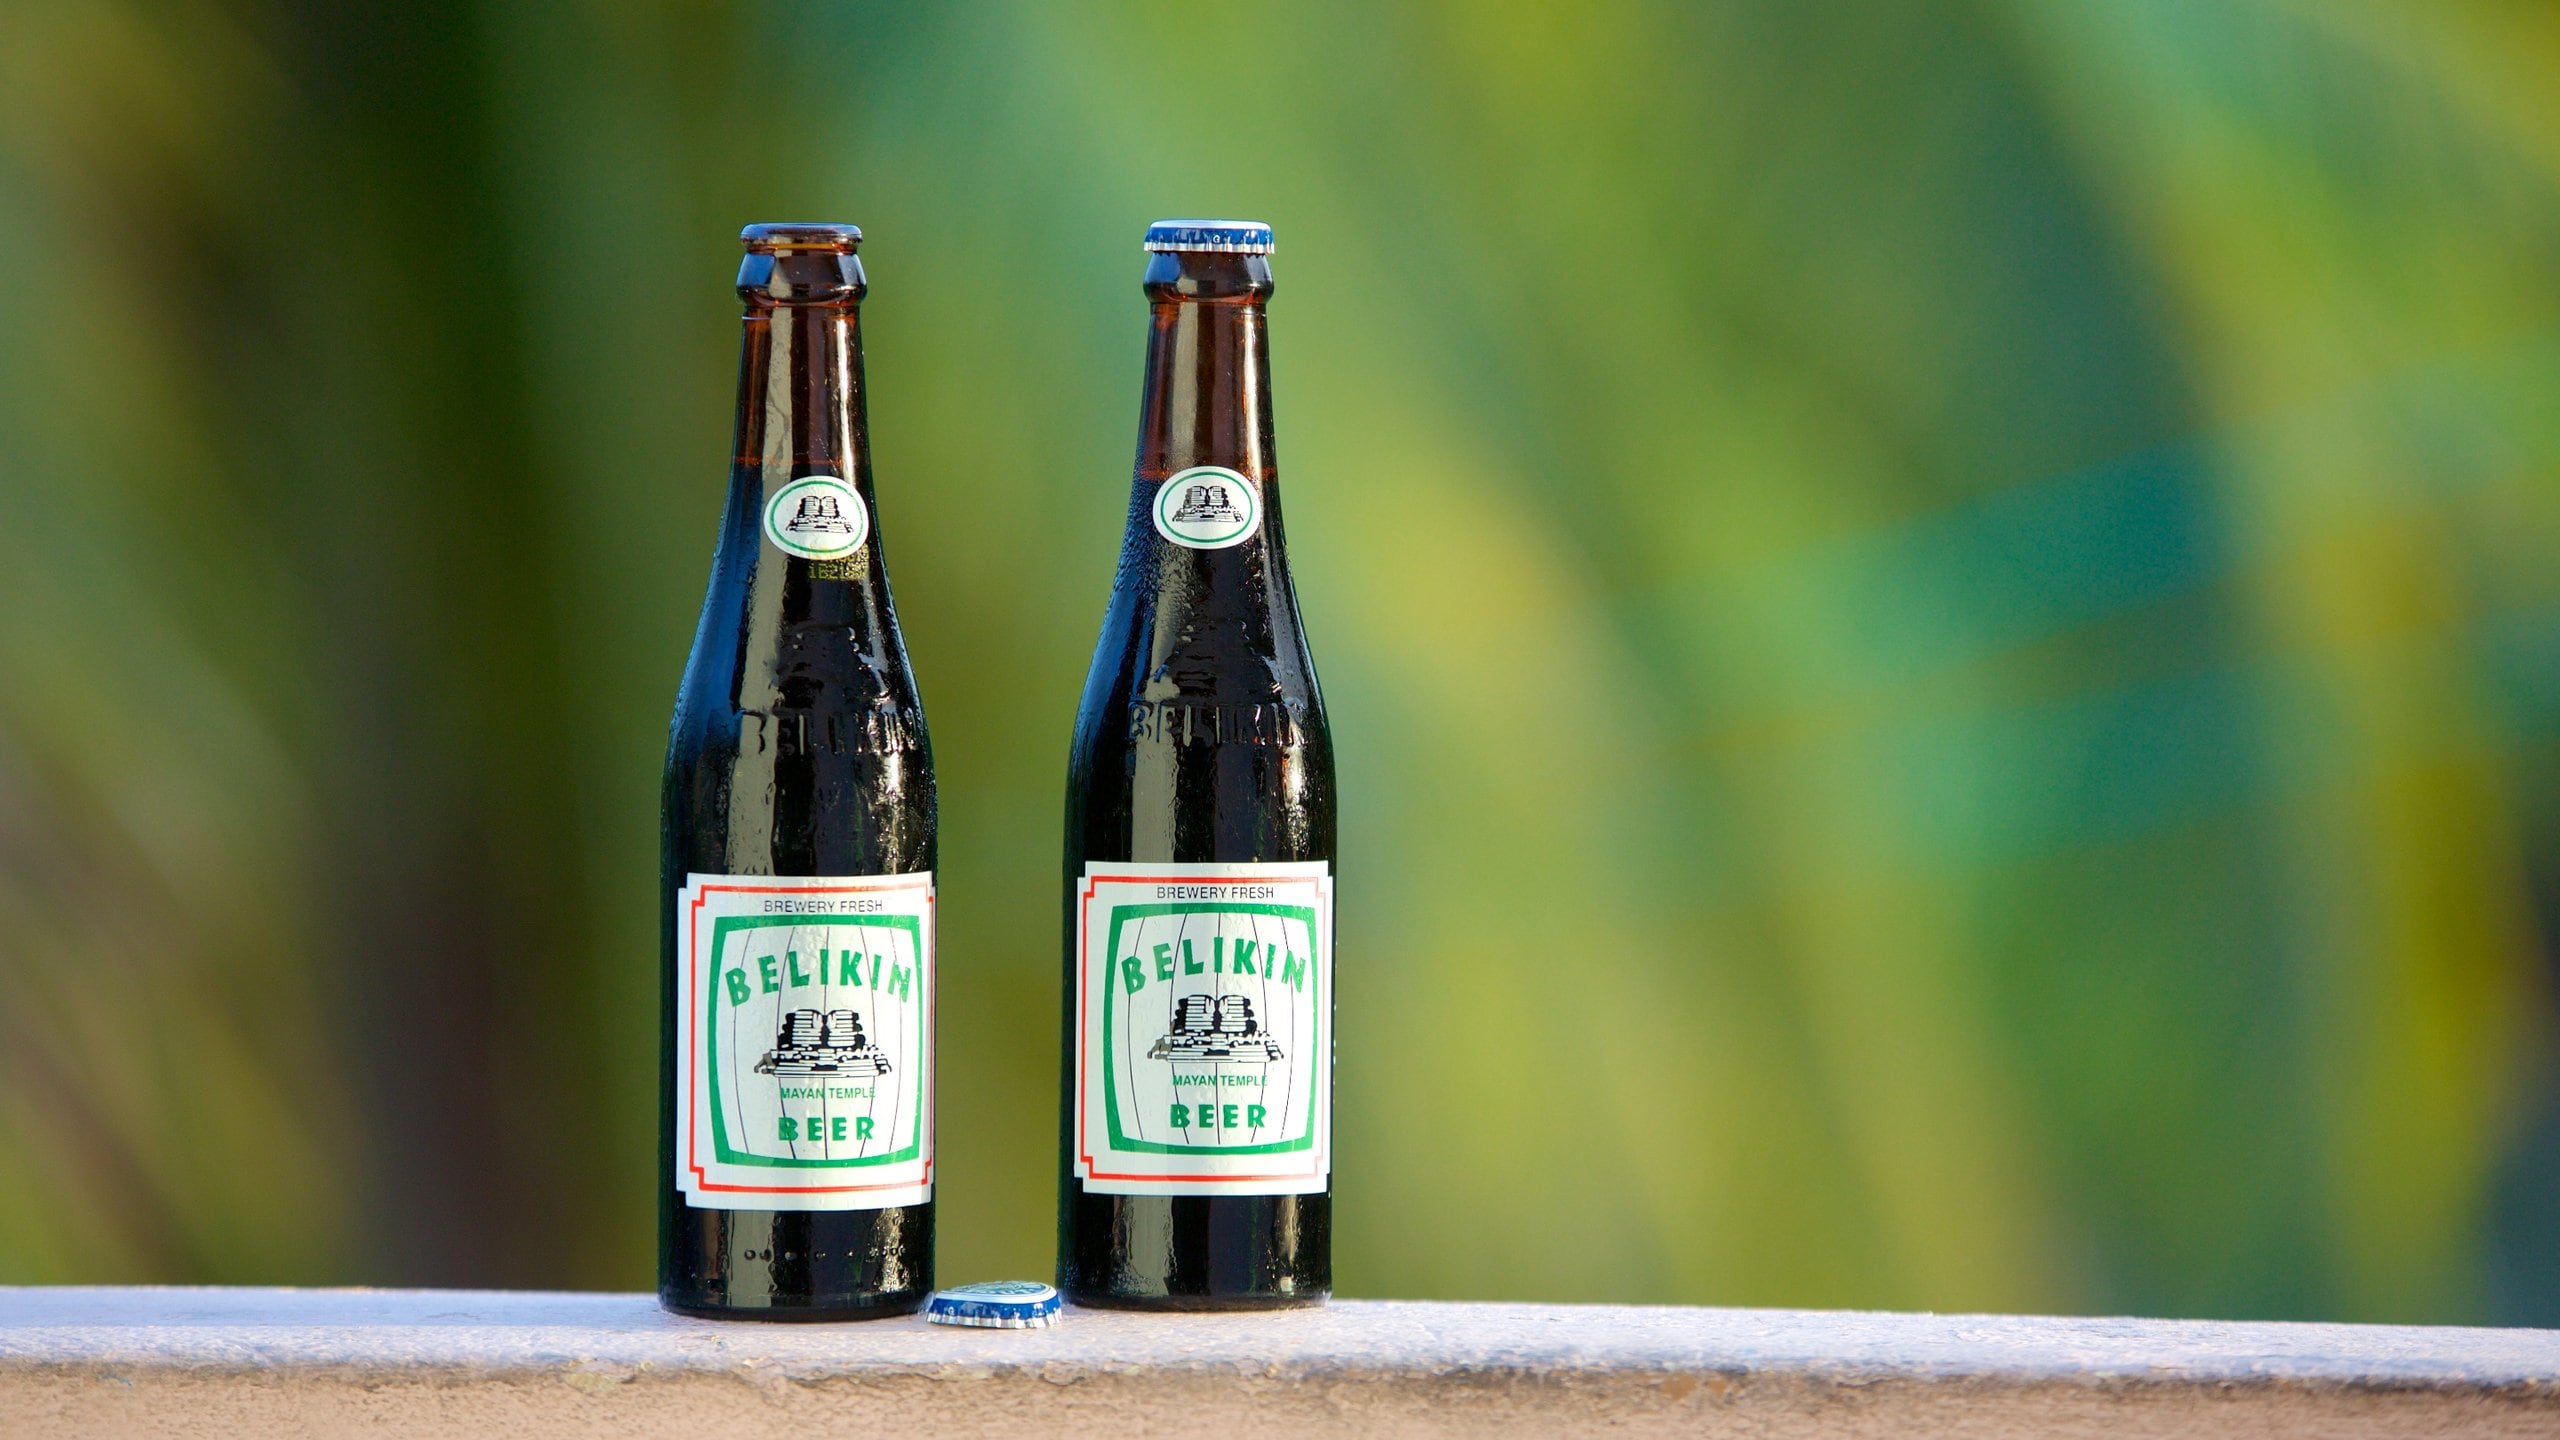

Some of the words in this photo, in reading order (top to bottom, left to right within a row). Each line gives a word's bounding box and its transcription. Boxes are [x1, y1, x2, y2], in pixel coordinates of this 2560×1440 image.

[1157, 886, 1227, 899] BREWERY
[1231, 886, 1274, 899] FRESH
[764, 900, 835, 913] BREWERY
[840, 899, 883, 913] FRESH
[1121, 936, 1306, 995] BELIKIN
[725, 948, 911, 1007] BELIKIN
[1172, 1074, 1217, 1087] MAYAN
[1220, 1074, 1268, 1087] TEMPLE
[780, 1087, 825, 1099] MAYAN
[828, 1086, 876, 1099] TEMPLE
[1170, 1104, 1267, 1128] BEER
[778, 1116, 875, 1141] BEER
